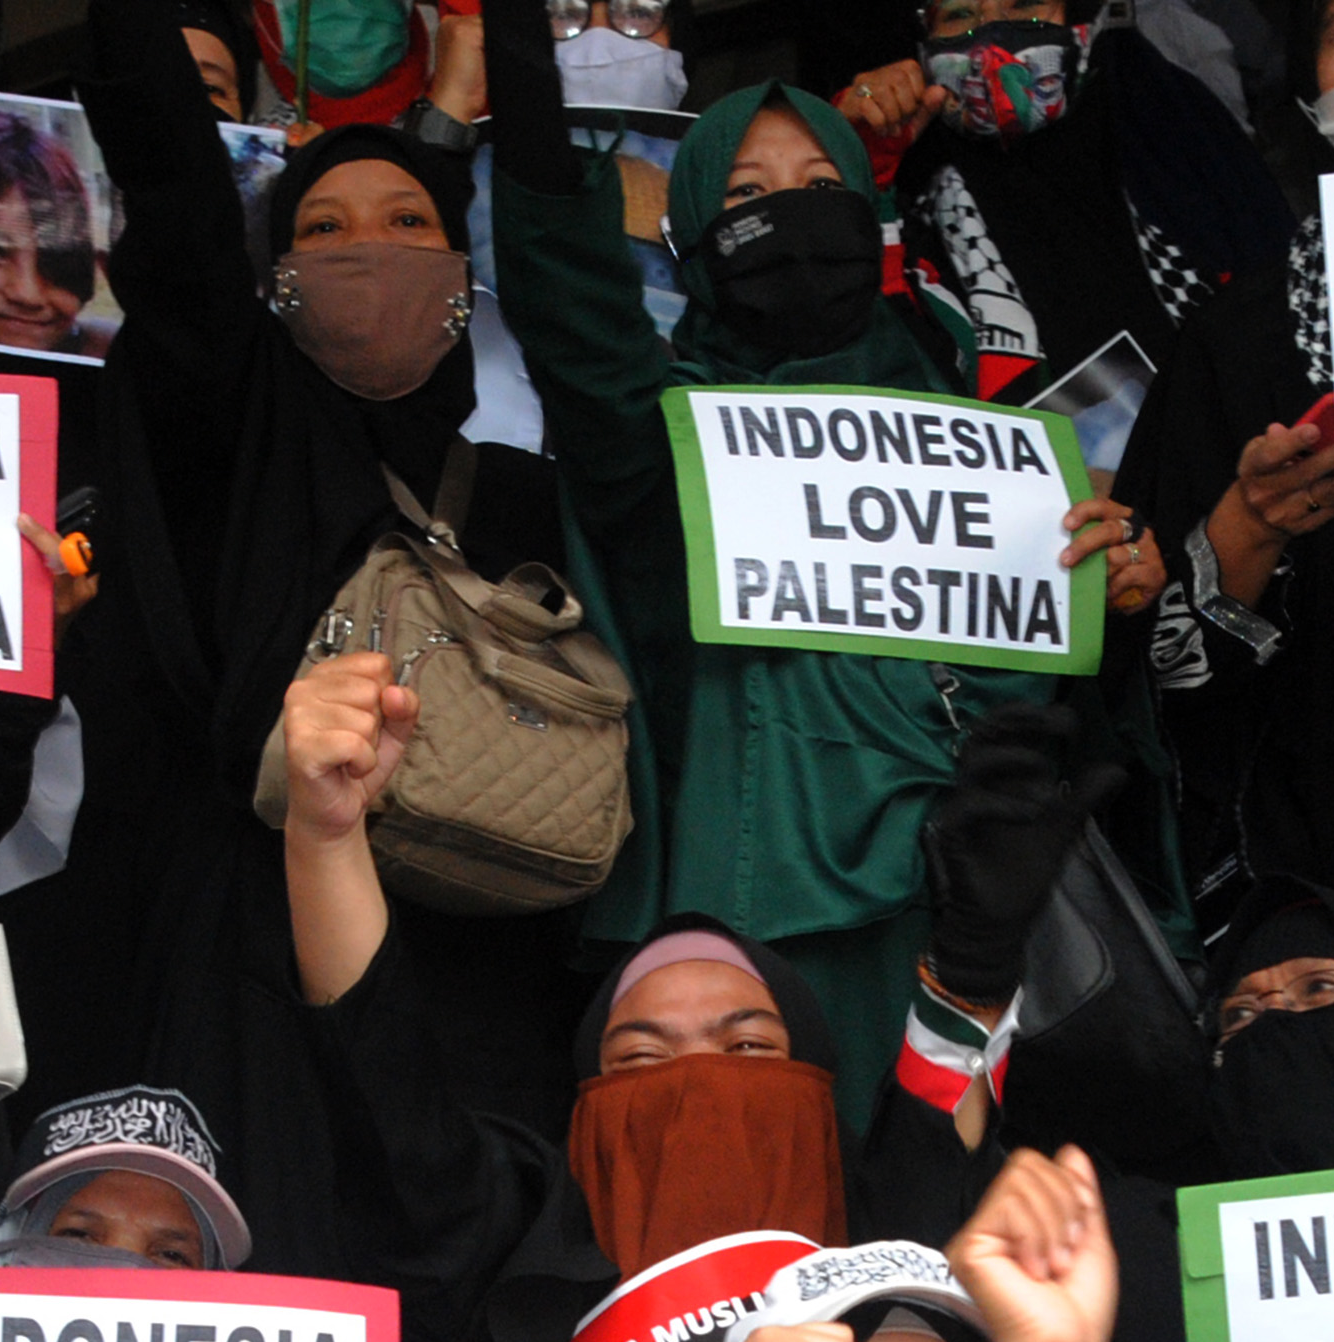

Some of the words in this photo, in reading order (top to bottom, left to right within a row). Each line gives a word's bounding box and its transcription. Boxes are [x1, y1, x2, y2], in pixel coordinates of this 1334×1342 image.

[717, 405, 1050, 476] INDONESIA
[803, 482, 994, 549] LOVE
[734, 557, 1063, 645] PALESTINA
